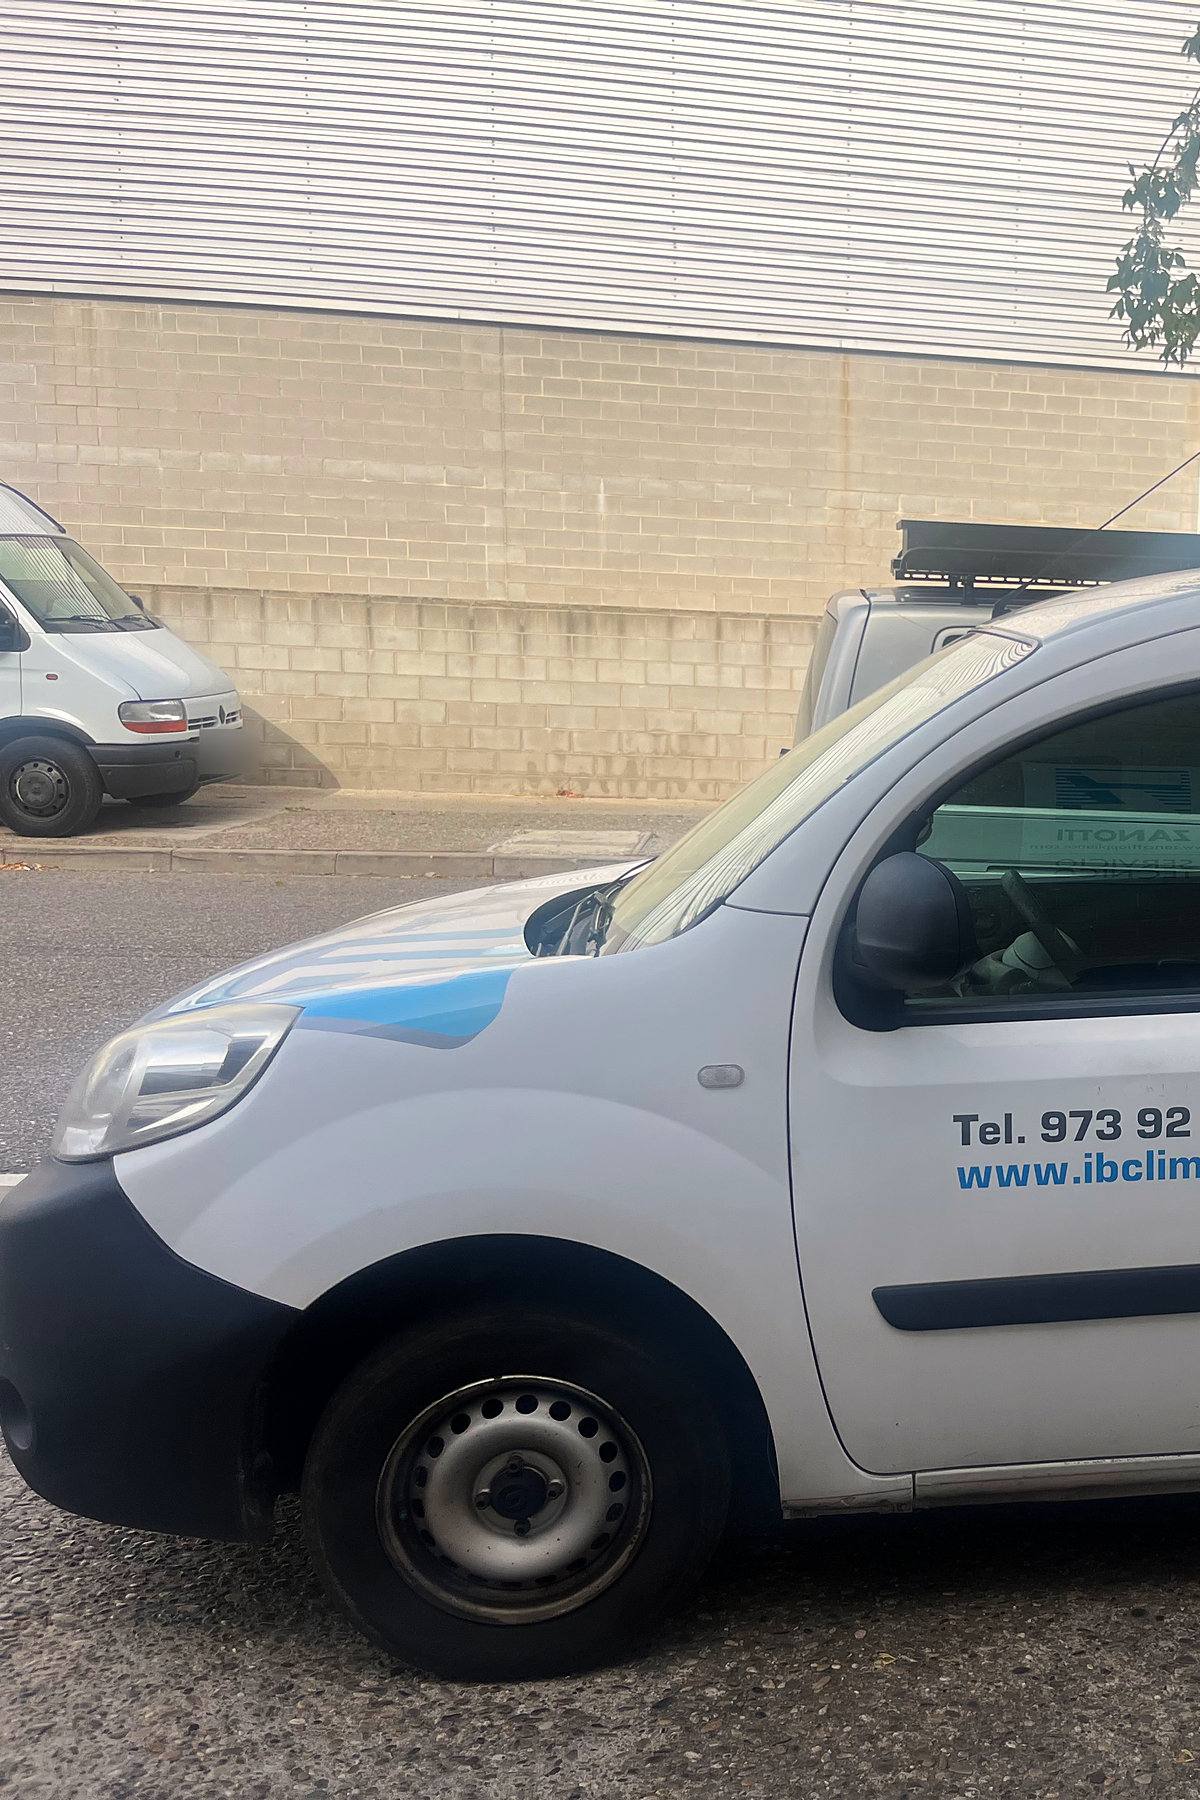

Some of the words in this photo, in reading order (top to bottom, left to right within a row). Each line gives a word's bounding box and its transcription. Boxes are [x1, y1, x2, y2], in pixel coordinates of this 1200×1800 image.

[953, 1112, 1026, 1146] Tel.
[1040, 1109, 1122, 1143] 973
[1136, 1106, 1191, 1139] 92
